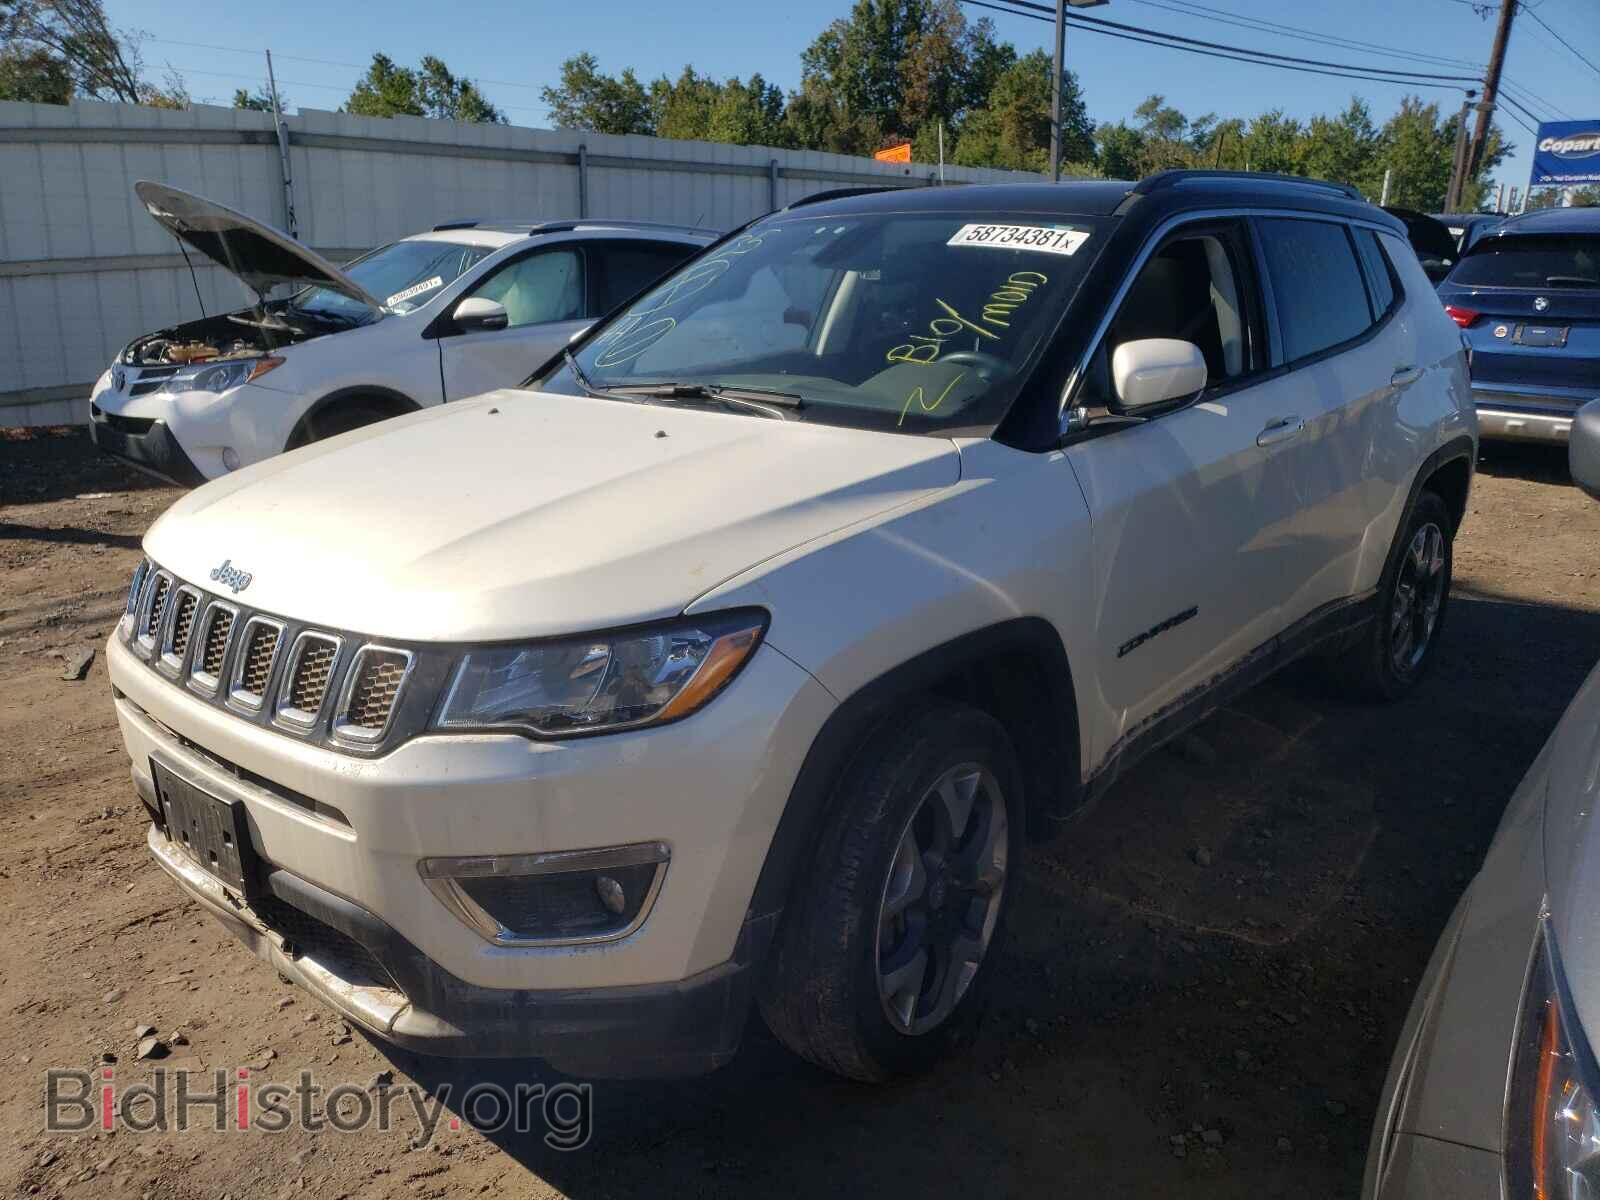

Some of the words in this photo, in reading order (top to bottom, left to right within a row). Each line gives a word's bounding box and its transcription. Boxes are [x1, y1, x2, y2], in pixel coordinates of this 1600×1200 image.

[1539, 137, 1600, 153] Copart
[209, 559, 253, 594] Jeep
[1117, 605, 1199, 657] COMP
